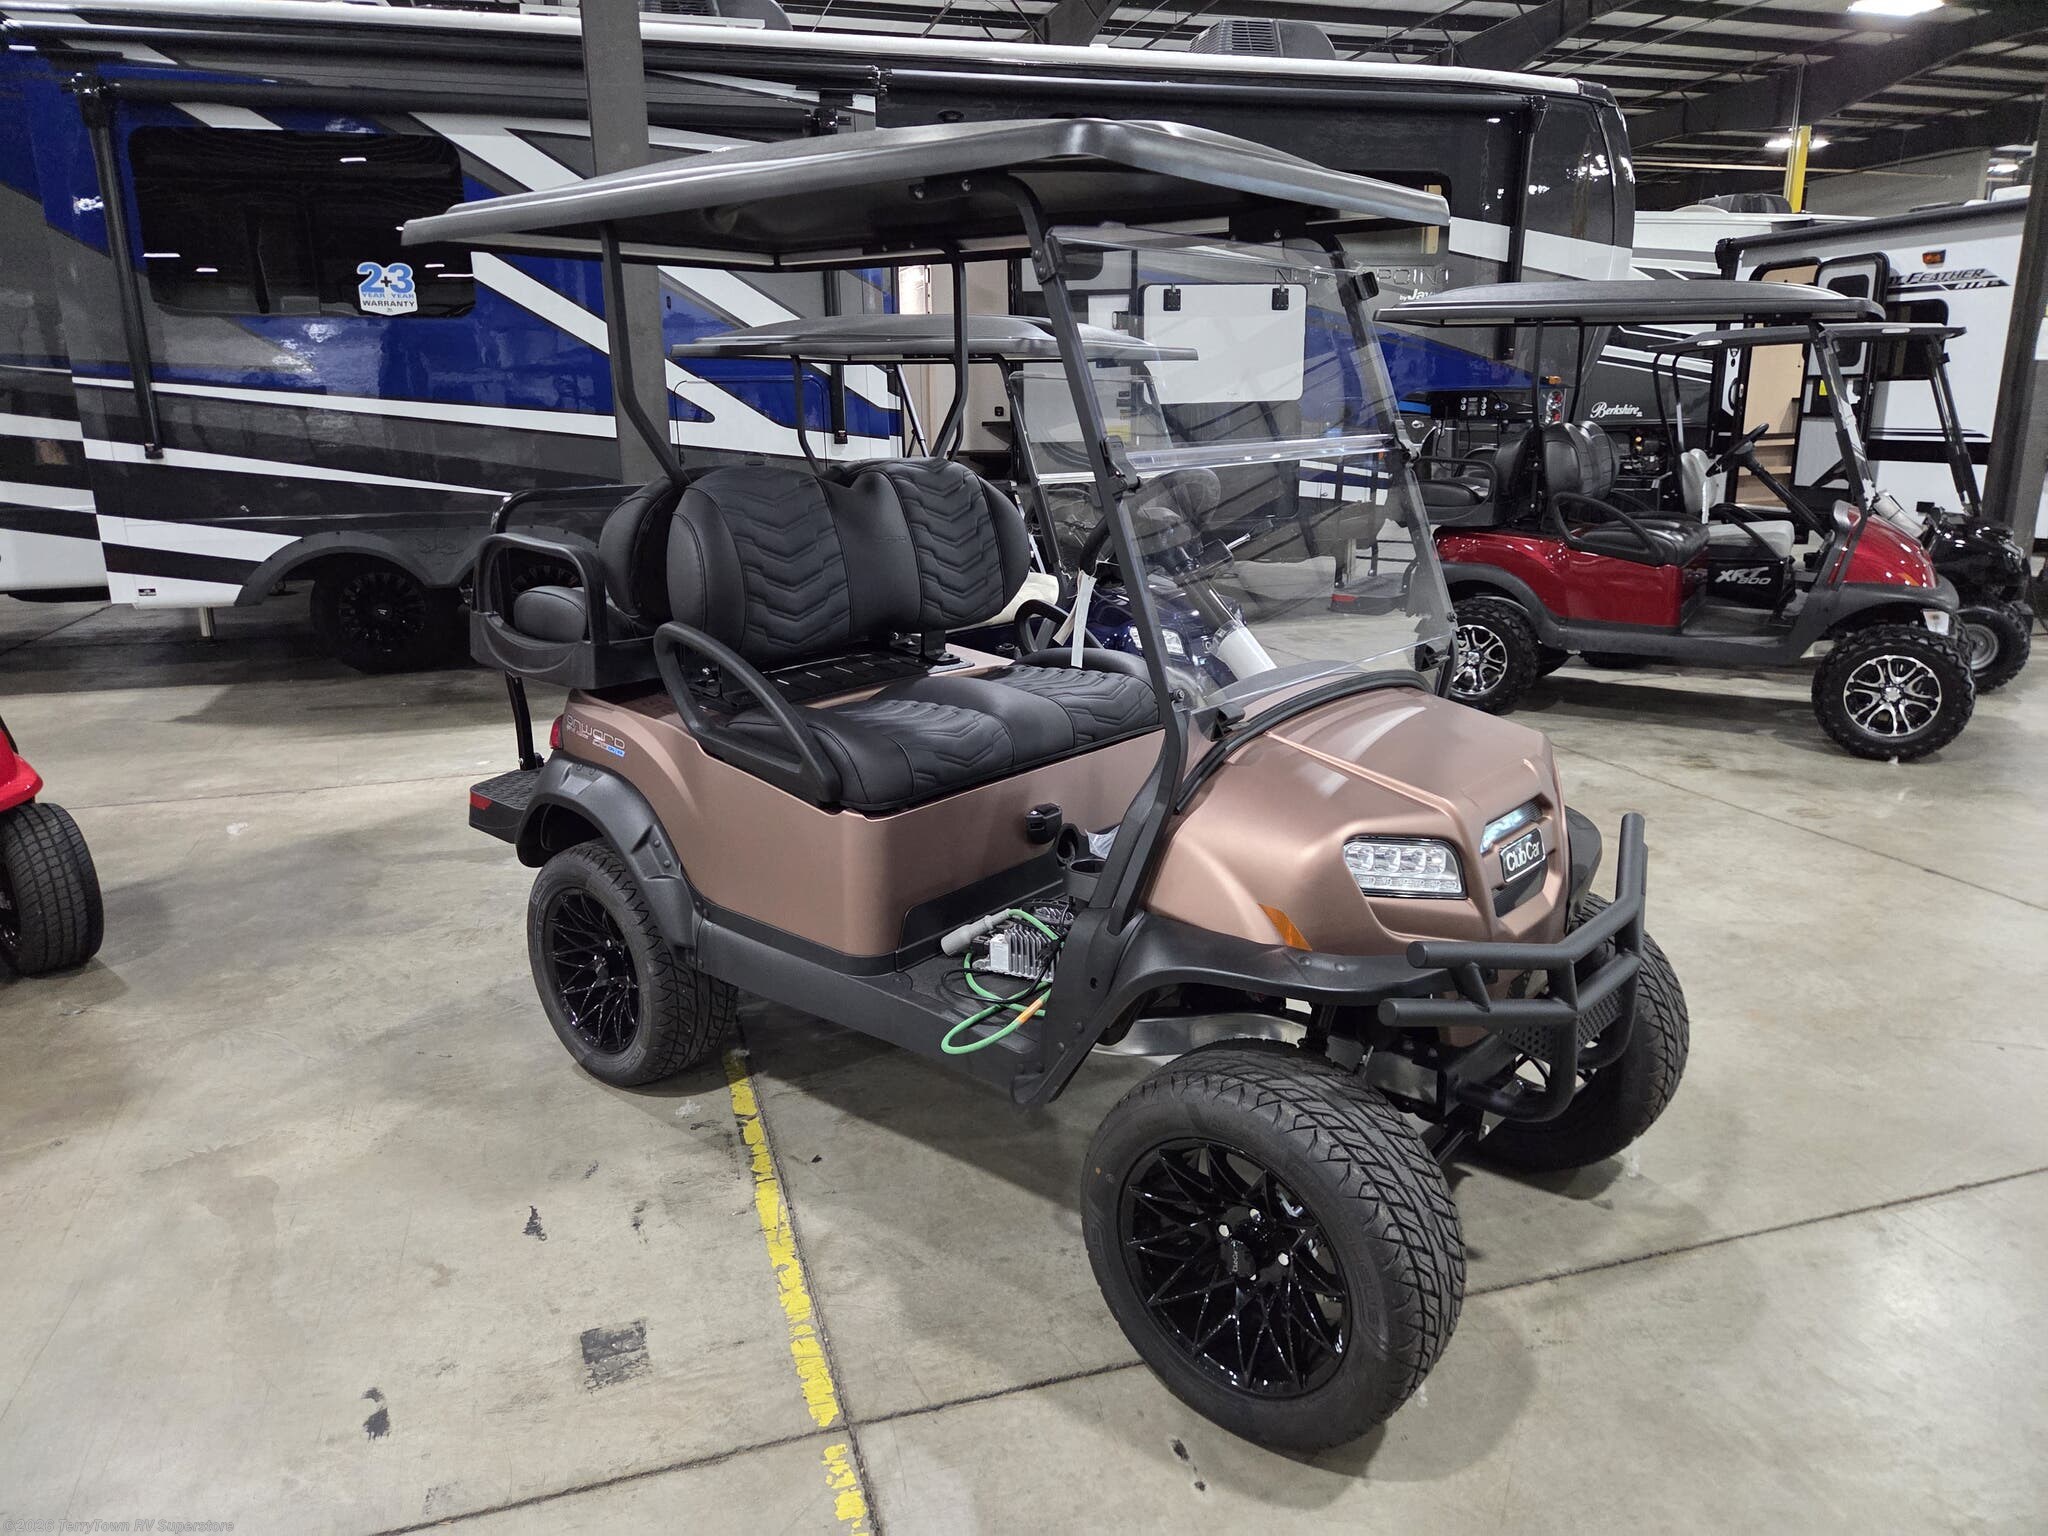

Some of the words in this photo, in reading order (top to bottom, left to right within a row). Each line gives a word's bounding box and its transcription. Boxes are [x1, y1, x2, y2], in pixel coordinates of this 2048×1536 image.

[1376, 267, 1454, 286] POINT
[1907, 268, 1986, 285] FEATHER
[362, 292, 385, 300] YEAR
[391, 292, 415, 300] YEAR
[362, 300, 416, 308] WARRANTY
[1589, 401, 1640, 419] Berkshire
[1715, 566, 1769, 583] XRT
[1506, 846, 1527, 872] Club
[1526, 841, 1540, 861] Car
